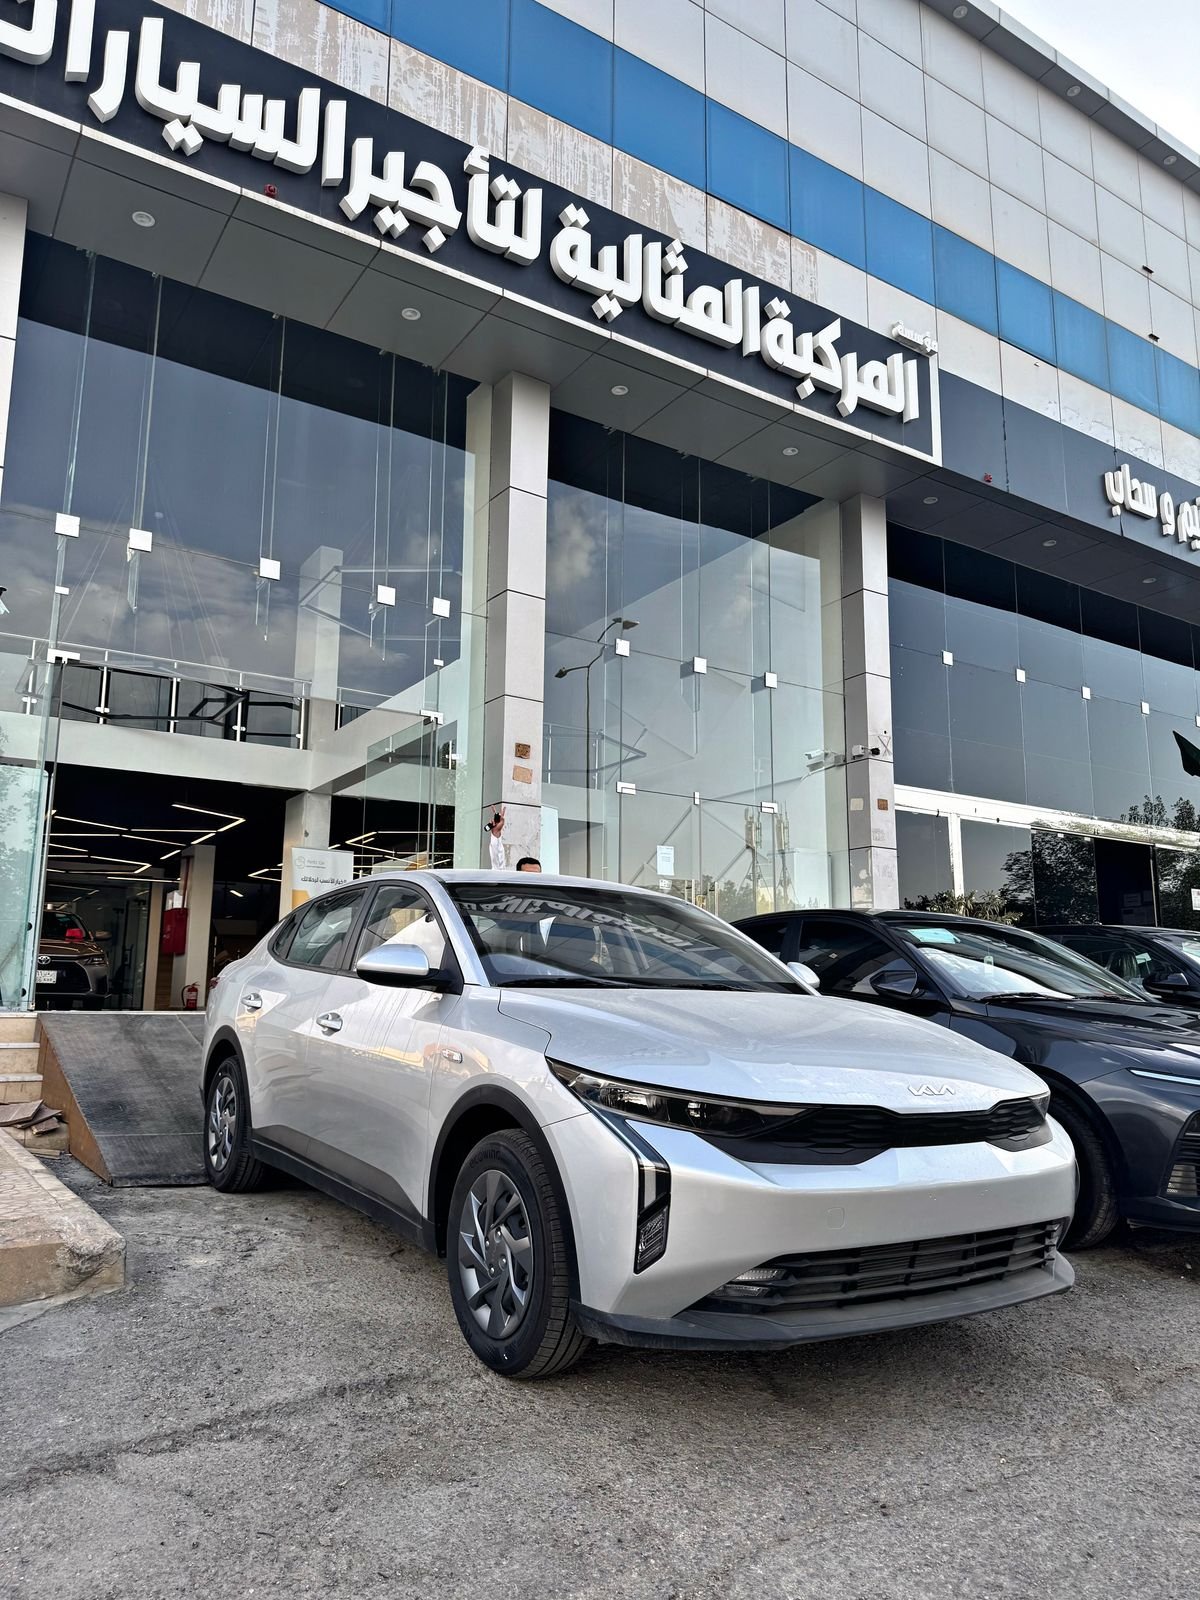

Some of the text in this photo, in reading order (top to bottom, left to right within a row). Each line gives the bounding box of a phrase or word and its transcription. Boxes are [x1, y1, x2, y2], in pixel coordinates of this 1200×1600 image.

[339, 145, 543, 267] لتأجير
[550, 203, 760, 358] المثالية
[760, 296, 918, 425] المركبة
[891, 319, 938, 357] مؤسسة
[1104, 463, 1158, 520] سحاب
[1159, 491, 1176, 536] و
